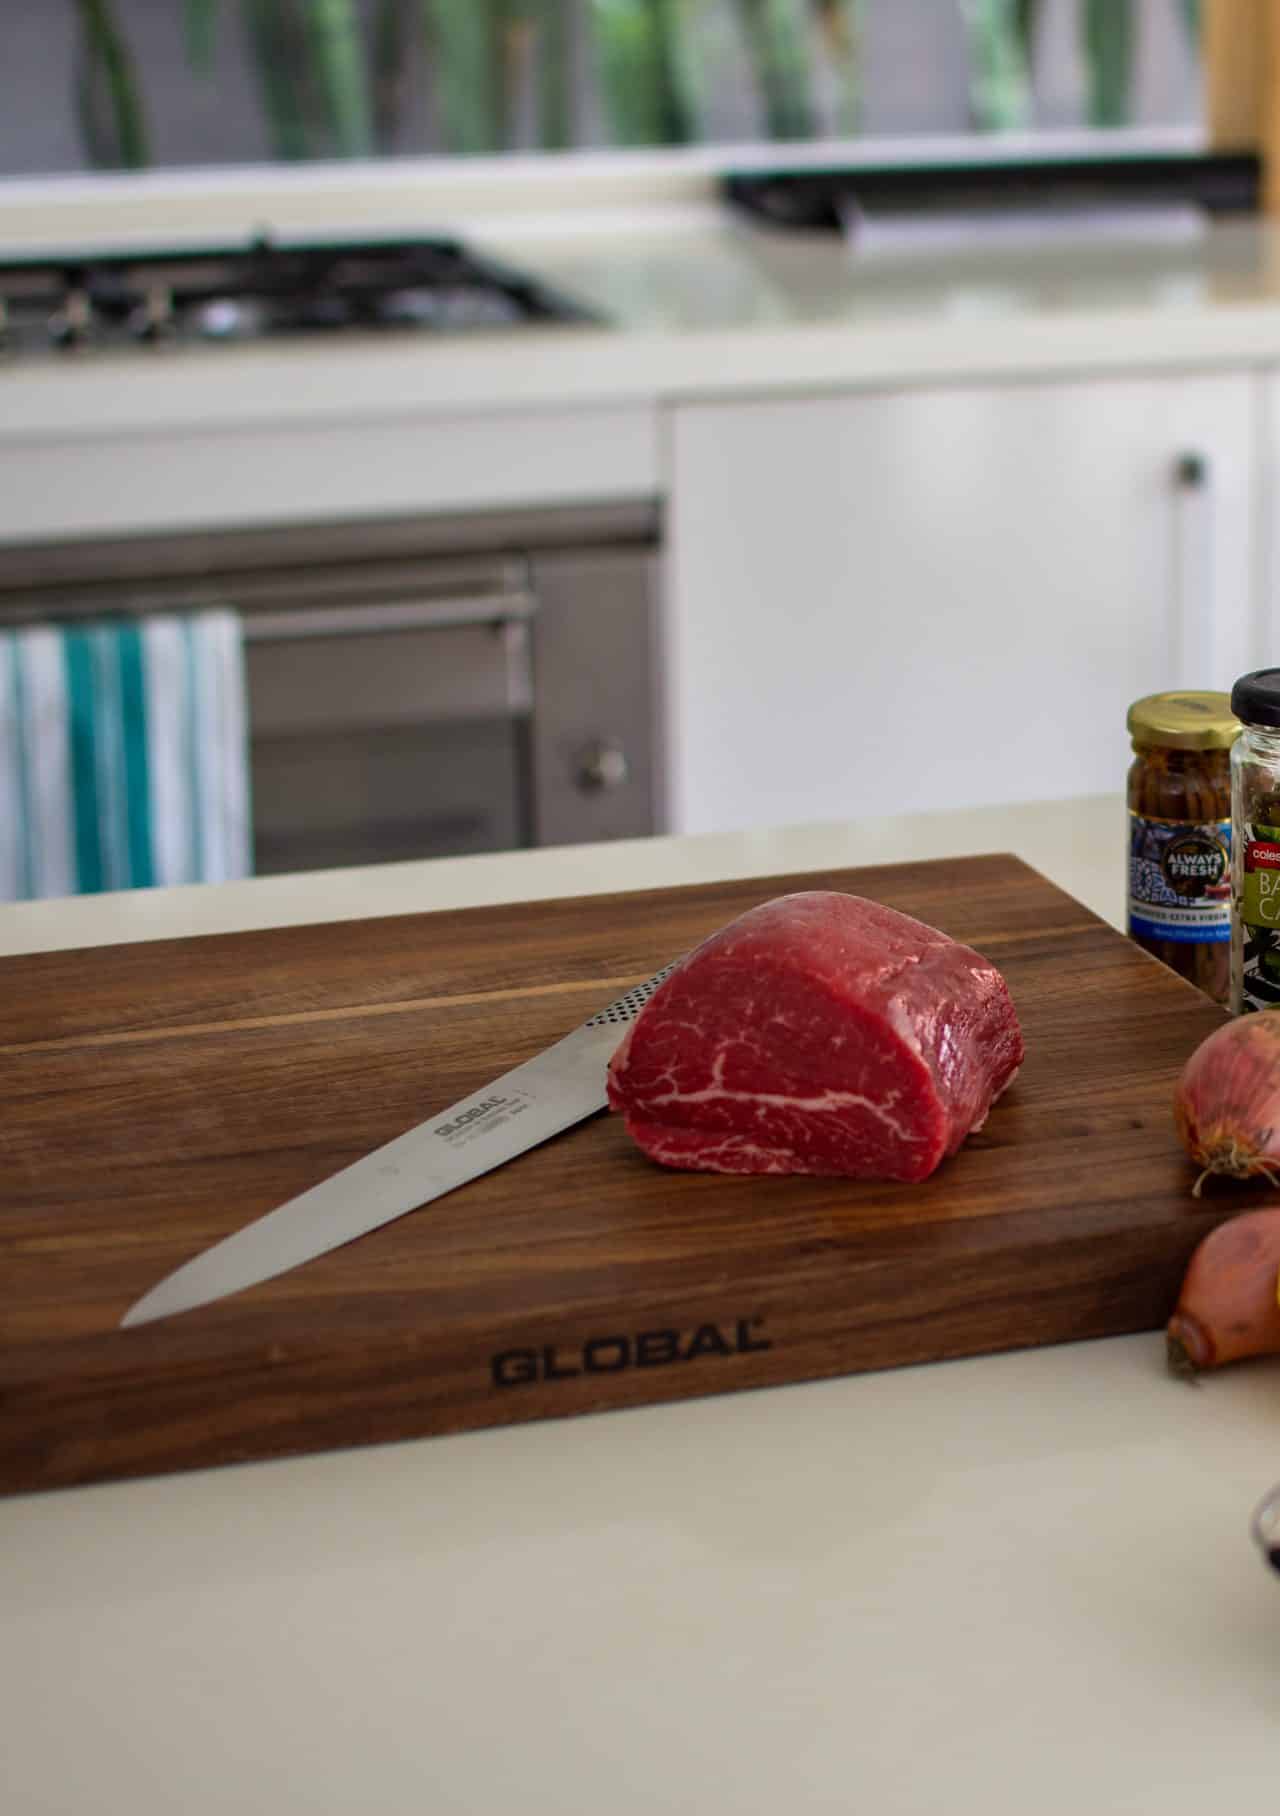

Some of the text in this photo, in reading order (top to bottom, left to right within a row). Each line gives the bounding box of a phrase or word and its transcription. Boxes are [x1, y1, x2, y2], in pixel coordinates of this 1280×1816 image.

[1167, 852, 1221, 865] ALWAYS
[1171, 863, 1218, 877] FRESH
[433, 1095, 508, 1137] GLOBAL
[490, 1317, 774, 1388] GLOBAL
